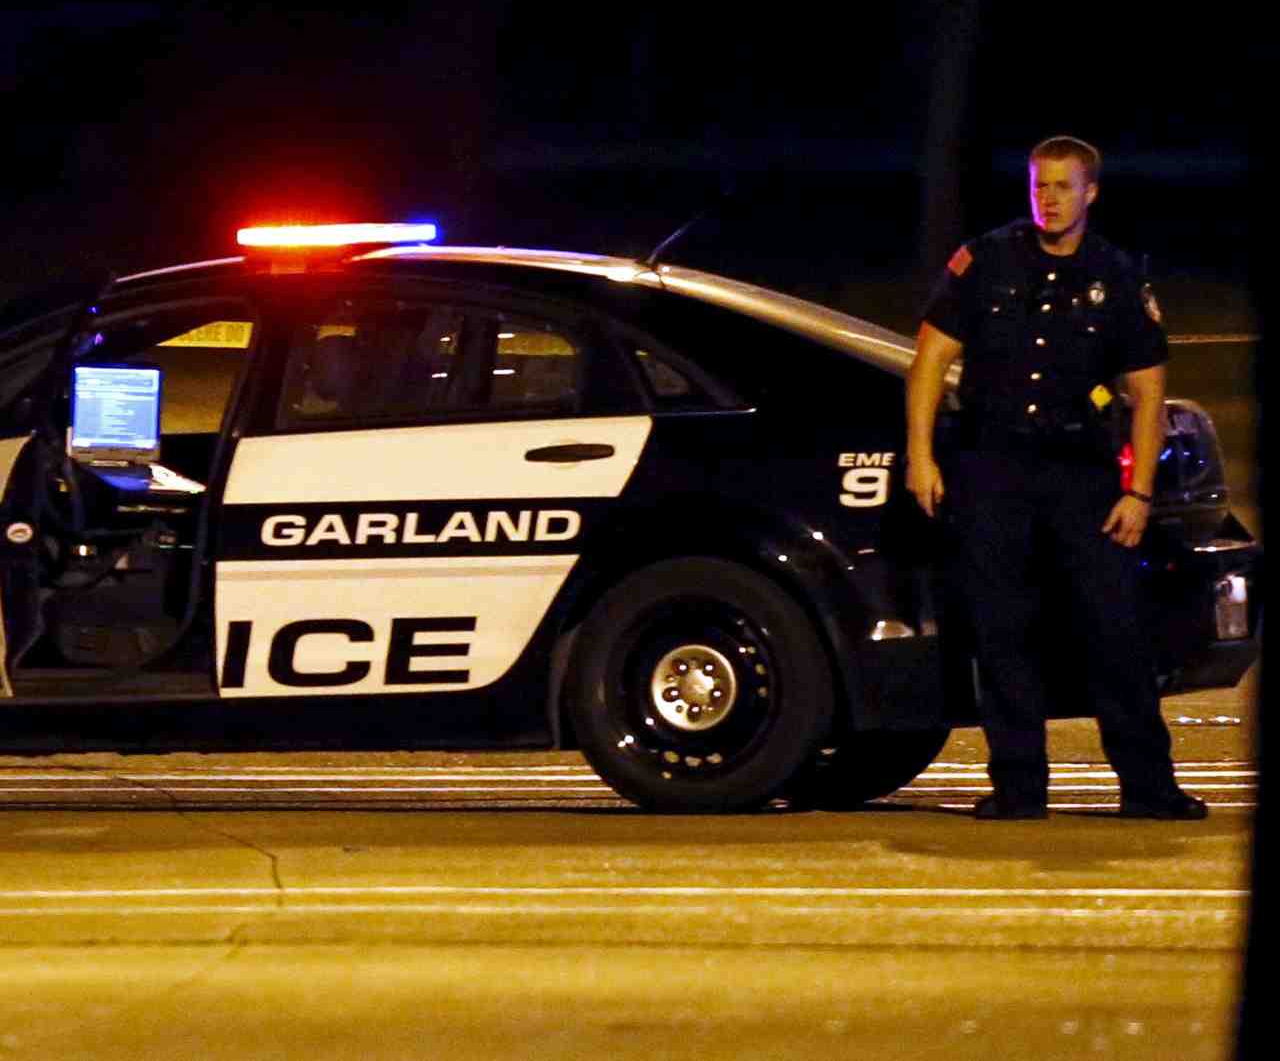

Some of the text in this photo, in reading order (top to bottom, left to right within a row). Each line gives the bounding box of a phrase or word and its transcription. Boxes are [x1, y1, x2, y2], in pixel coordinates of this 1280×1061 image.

[838, 452, 896, 467] EME
[840, 467, 889, 507] 9
[260, 509, 582, 546] GARLAND
[221, 616, 477, 688] ICE
